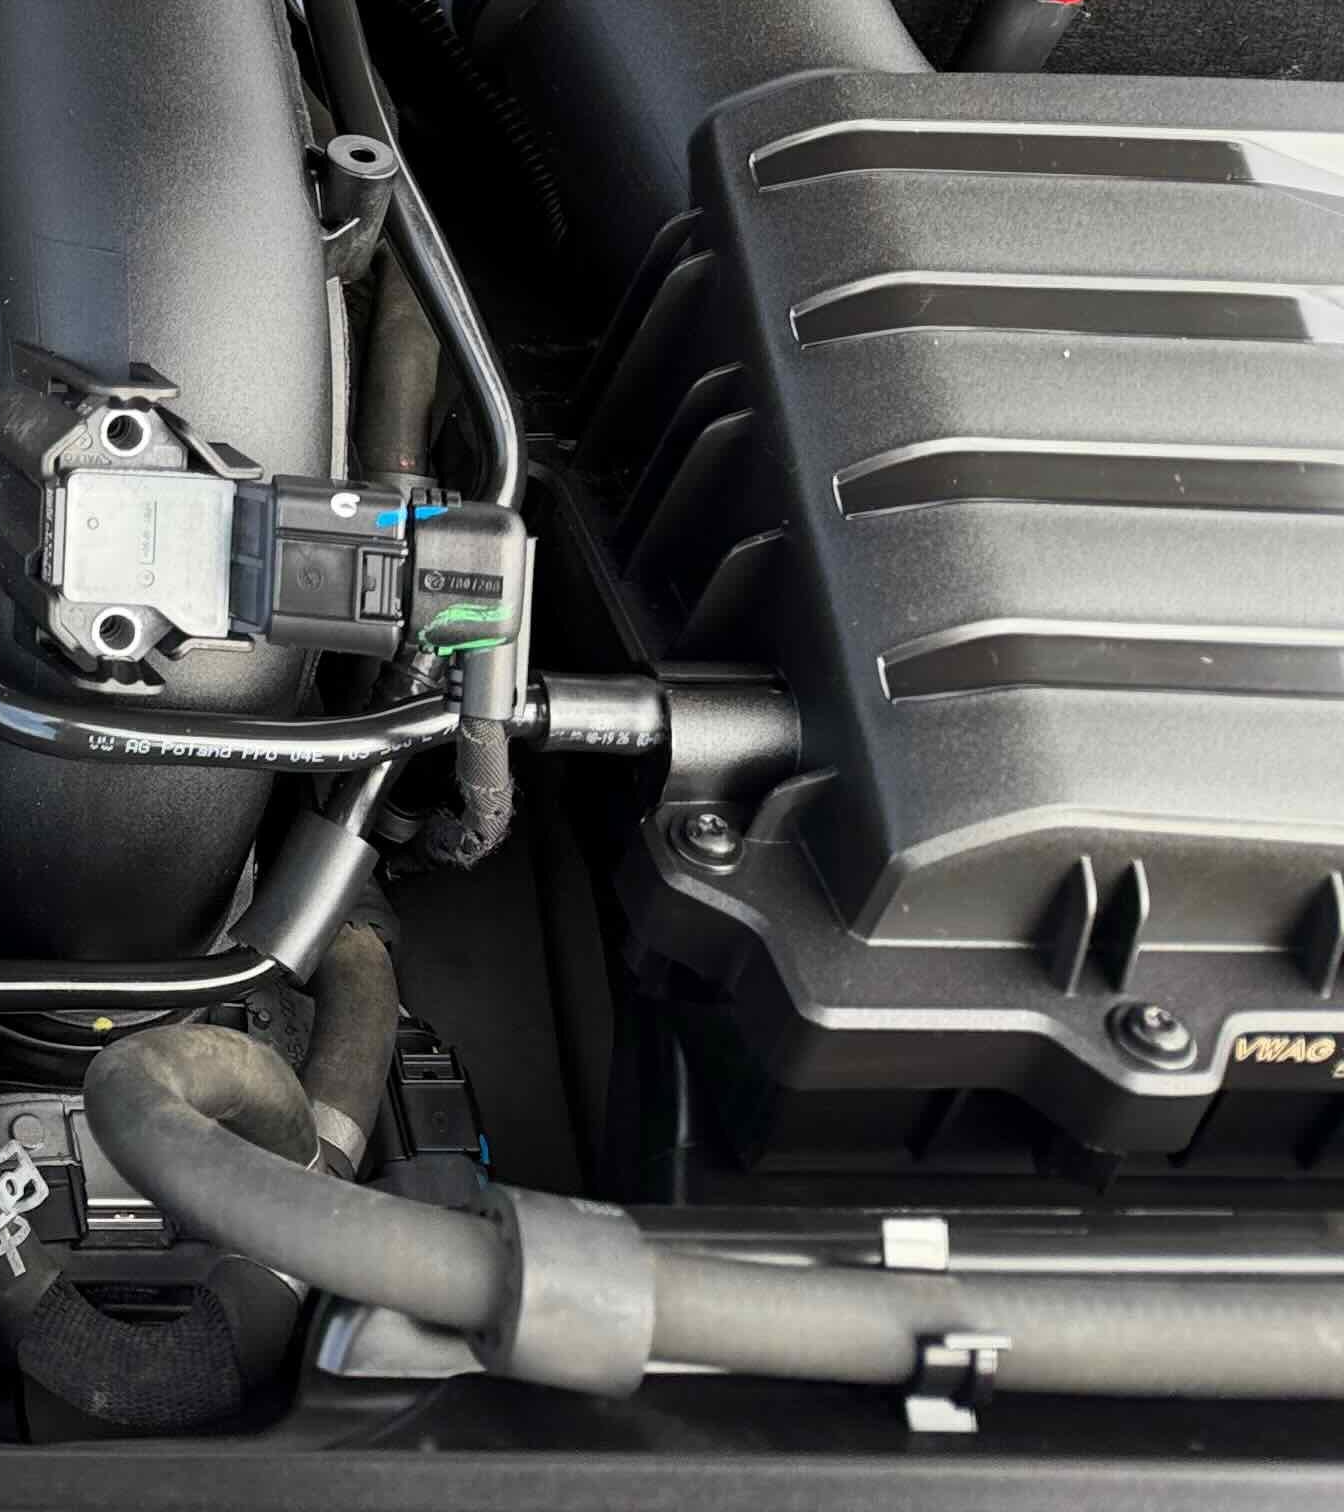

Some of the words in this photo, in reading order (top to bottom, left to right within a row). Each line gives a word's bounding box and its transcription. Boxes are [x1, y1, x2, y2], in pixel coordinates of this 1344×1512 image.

[125, 740, 151, 755] AG
[160, 744, 231, 760] Poland
[1234, 1035, 1337, 1063] VWAG
